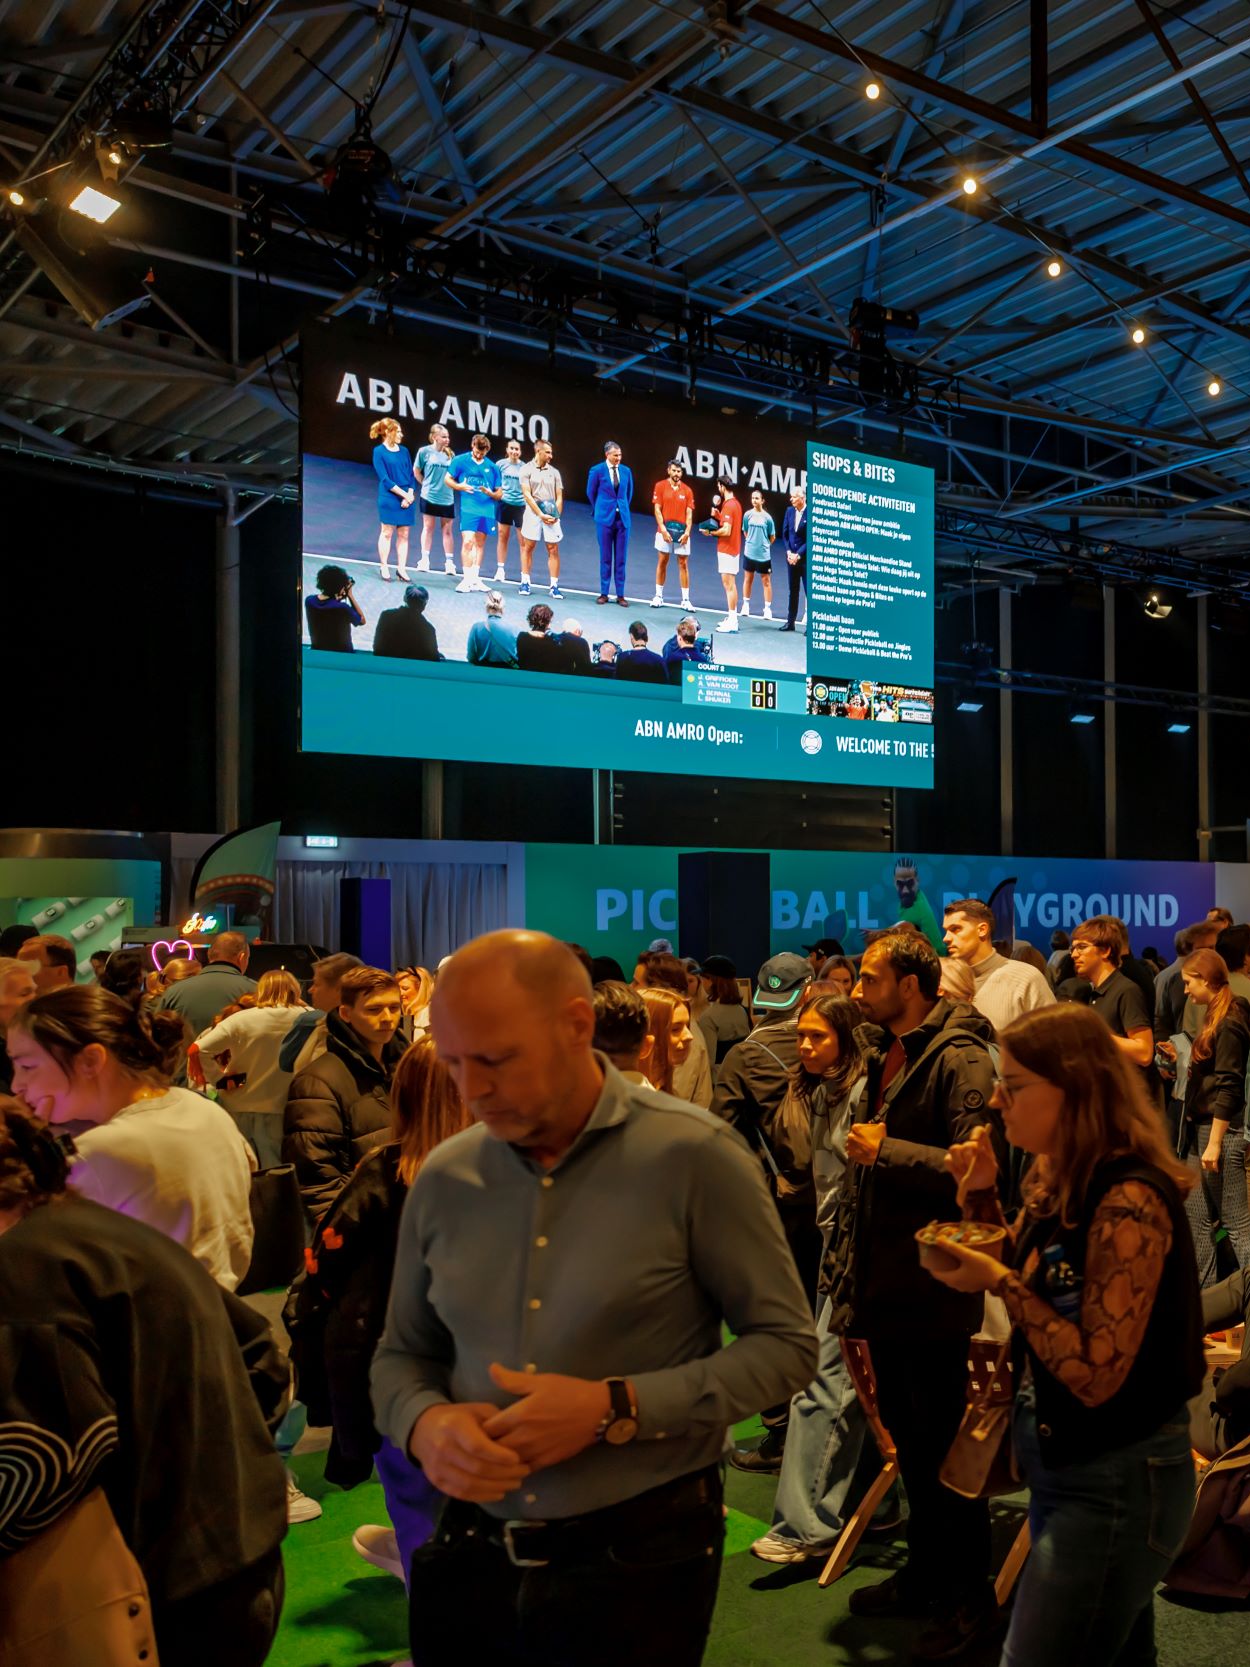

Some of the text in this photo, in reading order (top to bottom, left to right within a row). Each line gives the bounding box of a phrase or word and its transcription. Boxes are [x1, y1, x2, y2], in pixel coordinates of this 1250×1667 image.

[812, 451, 896, 483] SHOPS & BITES
[812, 482, 916, 513] DOORLOPENDE ACTIVITEITEN
[812, 506, 824, 515] ABN
[824, 508, 838, 518] AMRO
[840, 521, 850, 530] ABN
[851, 522, 866, 532] AMRO
[812, 544, 824, 552] ABN
[824, 546, 838, 556] AMRO
[838, 548, 852, 558] OPEN
[812, 554, 824, 562] ABN
[824, 556, 838, 565] AMRO
[812, 610, 840, 623] Pickleball
[698, 662, 719, 672] COURT
[755, 682, 774, 694] 0 0
[882, 686, 904, 696] HITS
[755, 696, 774, 708] 0 0
[634, 720, 744, 745] ABN AMRO Open:
[836, 736, 890, 755] WELCOME
[893, 740, 907, 756] TO
[910, 741, 928, 758] THE
